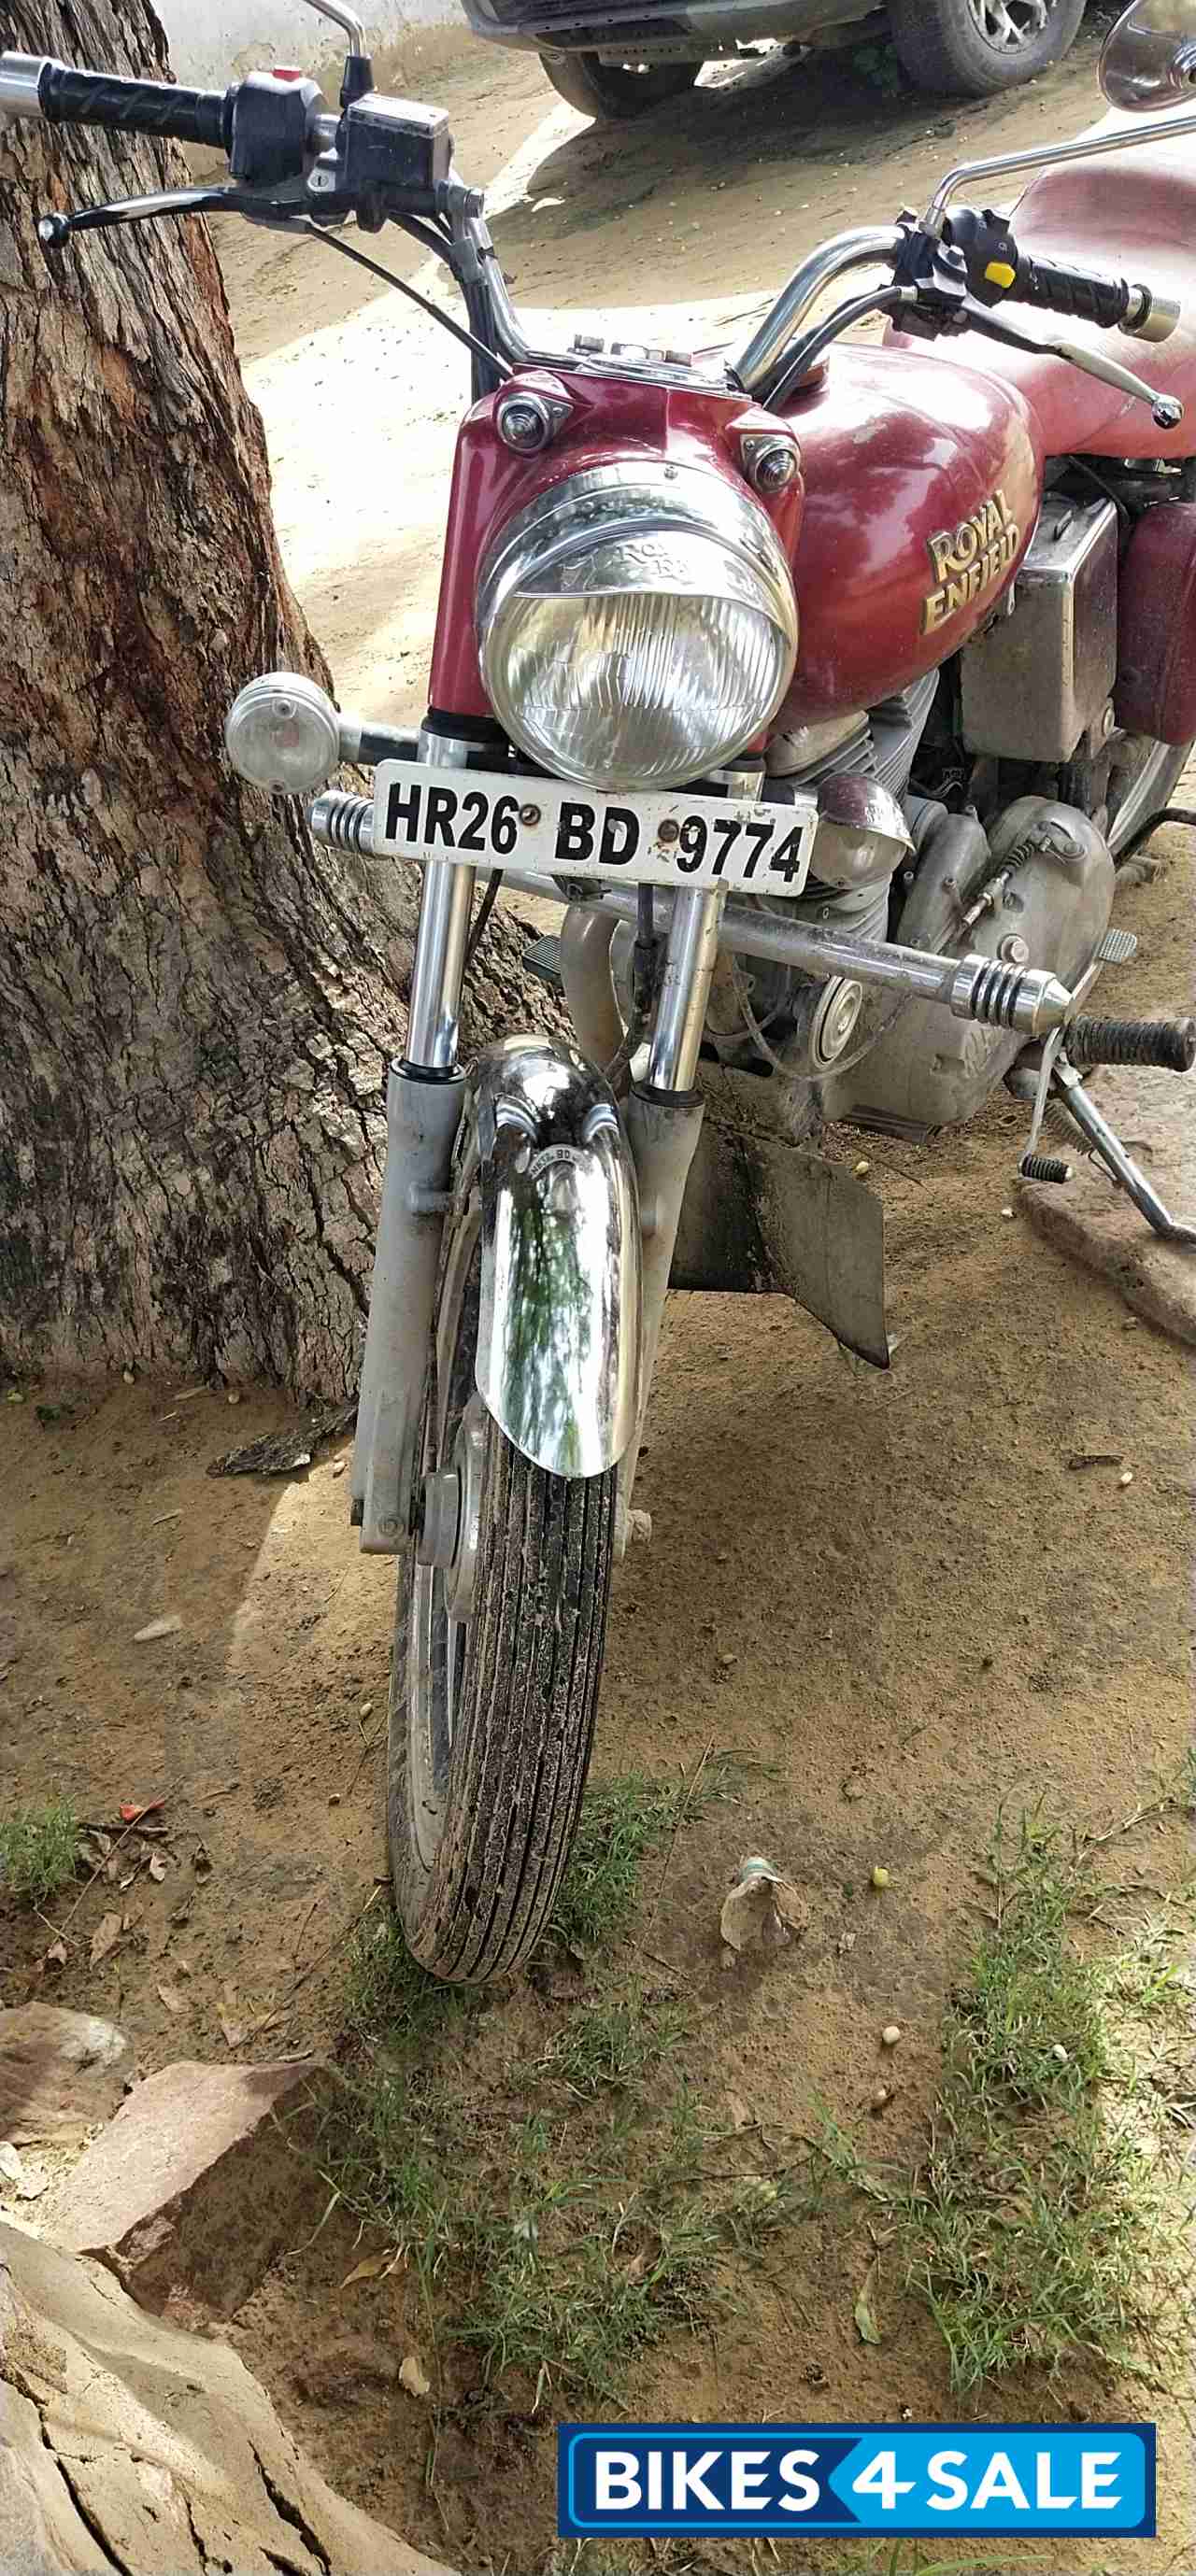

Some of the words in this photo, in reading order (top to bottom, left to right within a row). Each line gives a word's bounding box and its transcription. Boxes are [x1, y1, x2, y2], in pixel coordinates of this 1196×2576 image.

[921, 523, 1021, 636] ENFIELD
[927, 489, 1013, 583] ROYAL
[384, 782, 520, 855] HR26
[554, 800, 640, 866] BD
[676, 814, 804, 884] 9774
